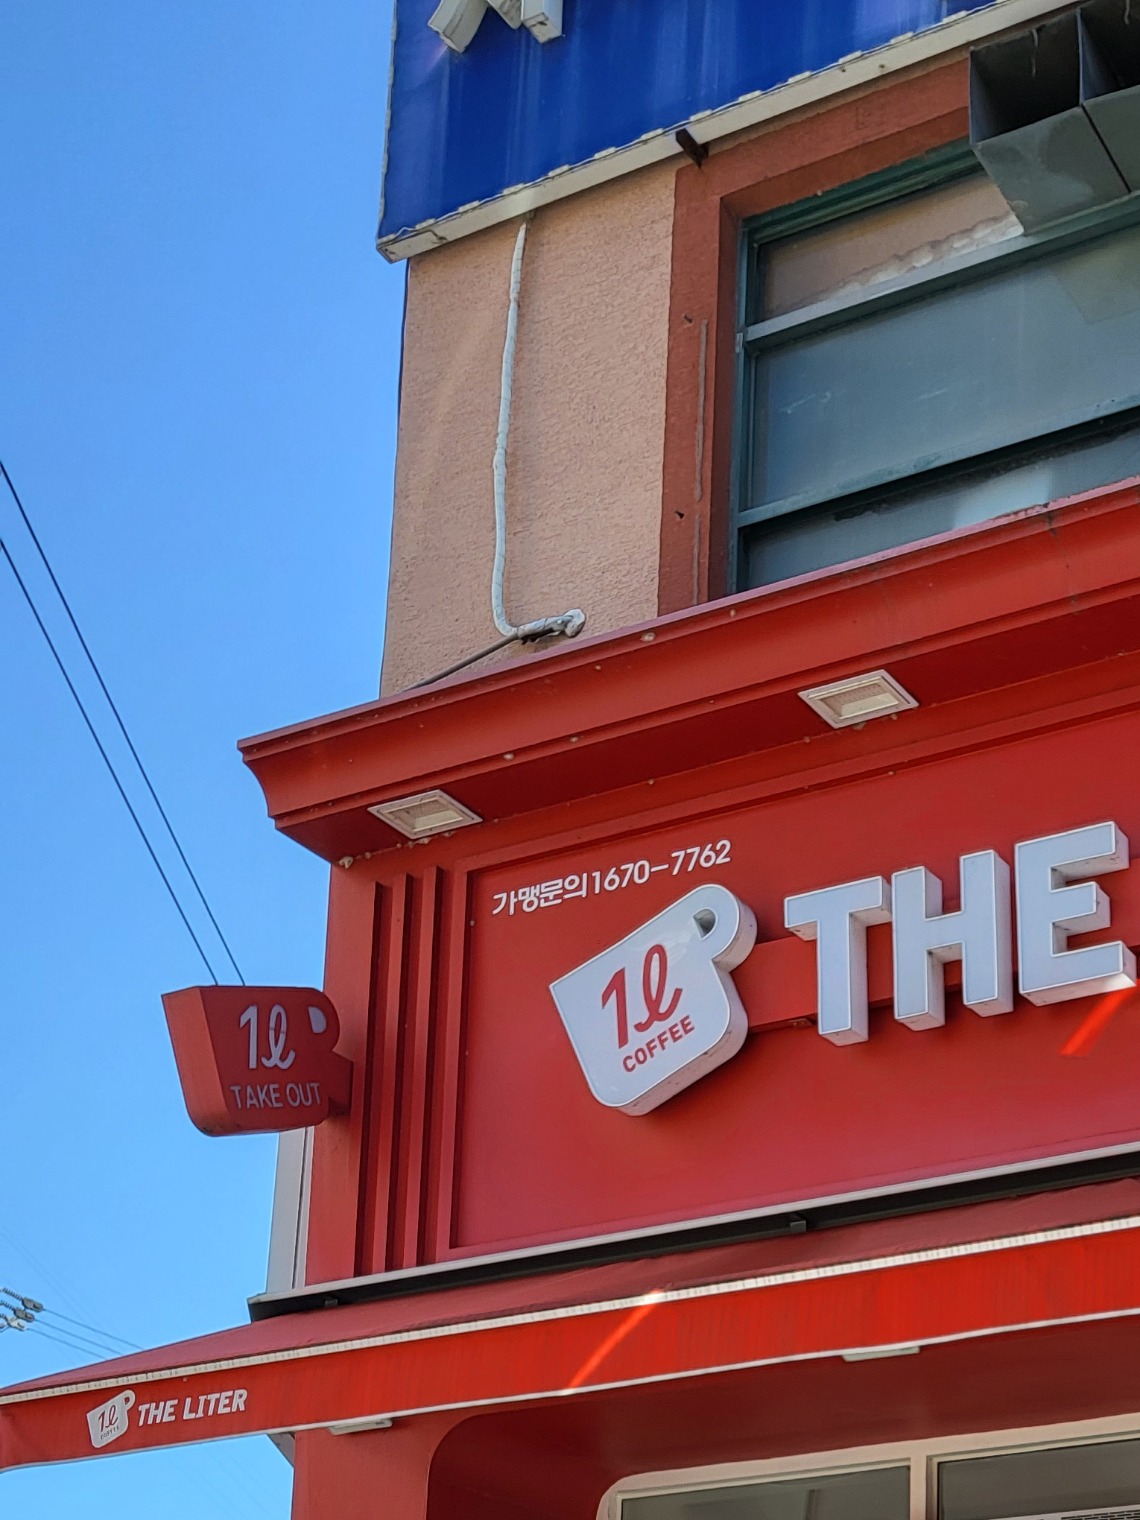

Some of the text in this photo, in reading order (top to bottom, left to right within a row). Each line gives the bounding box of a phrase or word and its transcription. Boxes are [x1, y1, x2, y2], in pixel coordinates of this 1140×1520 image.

[785, 821, 1137, 1046] THE
[622, 1015, 695, 1073] COFFEE
[230, 1082, 321, 1110] TAKE OUT
[138, 1389, 248, 1426] THE LITER
